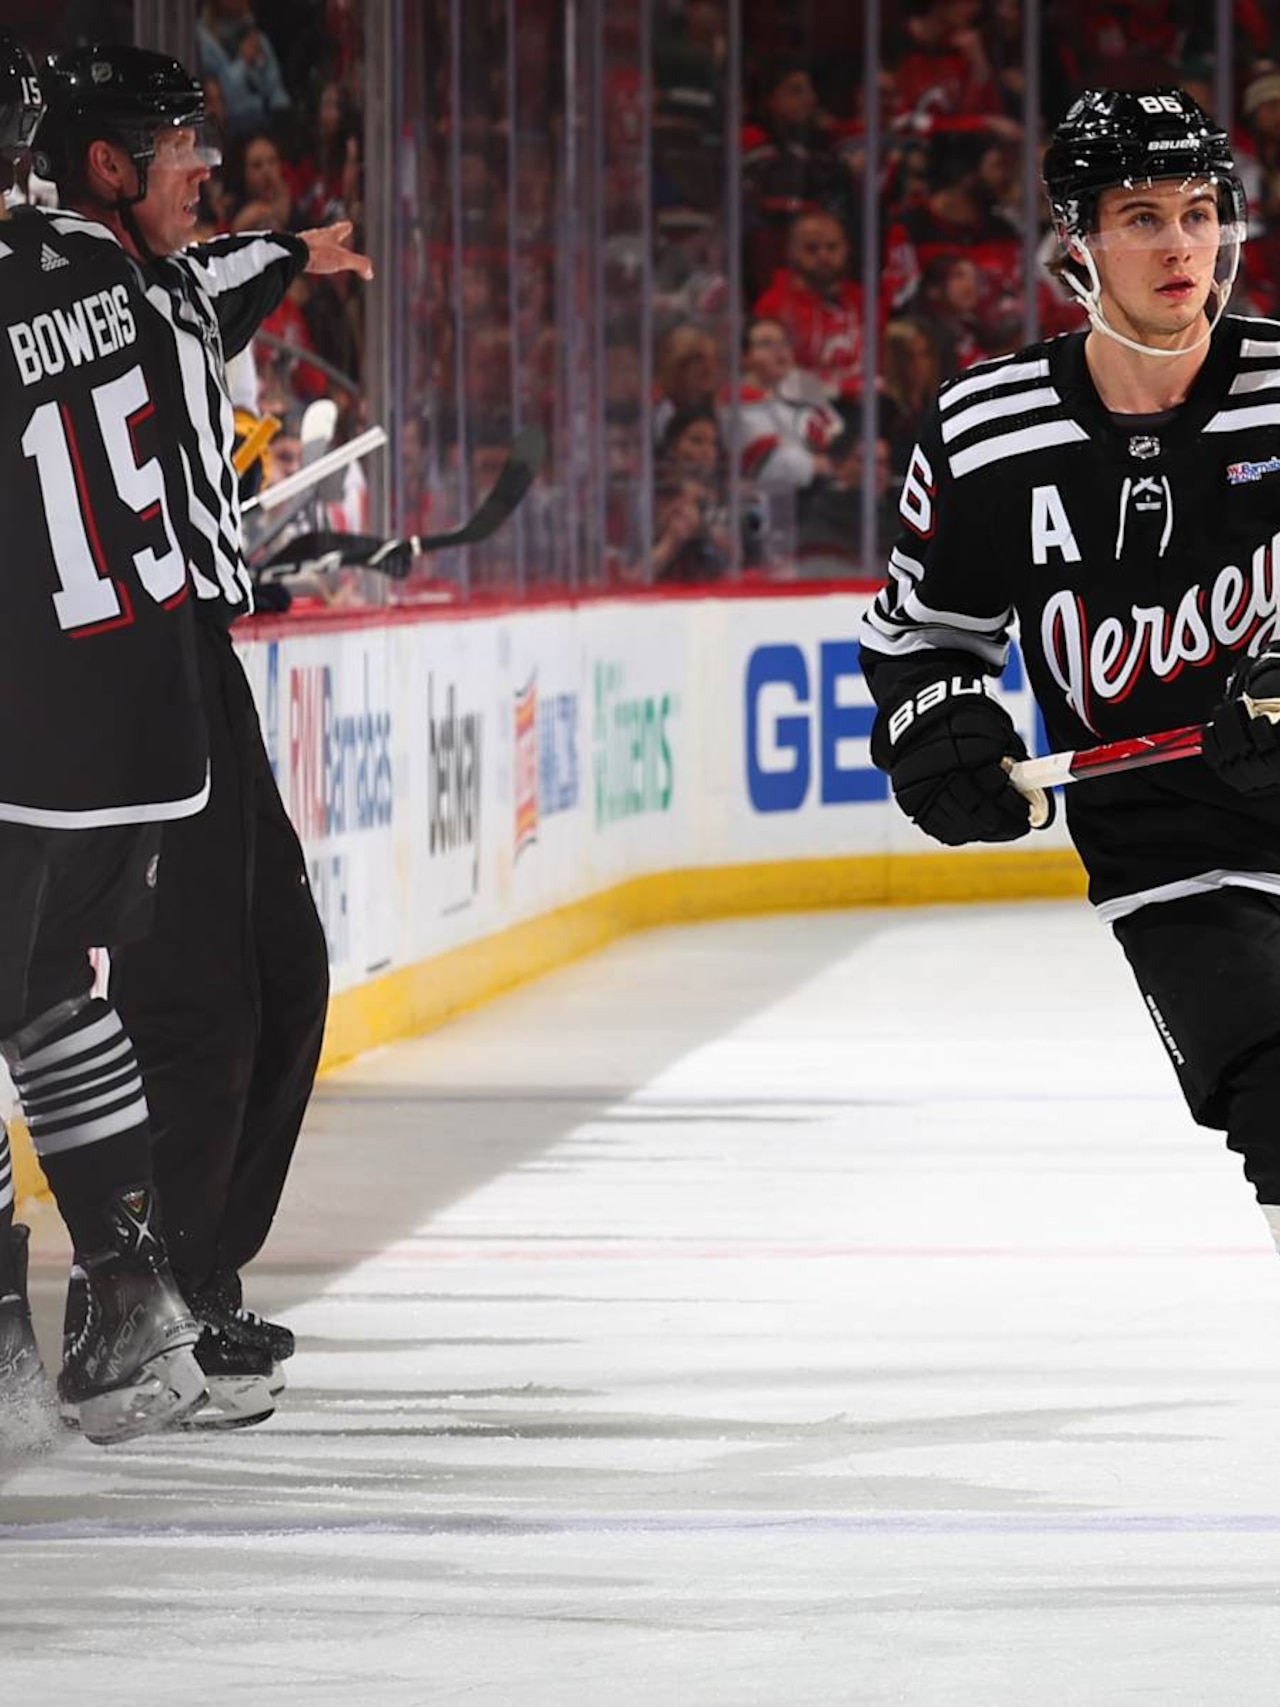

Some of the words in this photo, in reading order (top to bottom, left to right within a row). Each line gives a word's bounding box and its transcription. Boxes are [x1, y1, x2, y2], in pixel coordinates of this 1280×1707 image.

[21, 76, 42, 104] 15
[1138, 96, 1183, 114] 86
[1147, 137, 1200, 151] BAUER
[7, 284, 137, 387] BOWERS
[21, 363, 189, 638] 15
[1031, 484, 1082, 565] A
[1146, 994, 1185, 1066] BAUER
